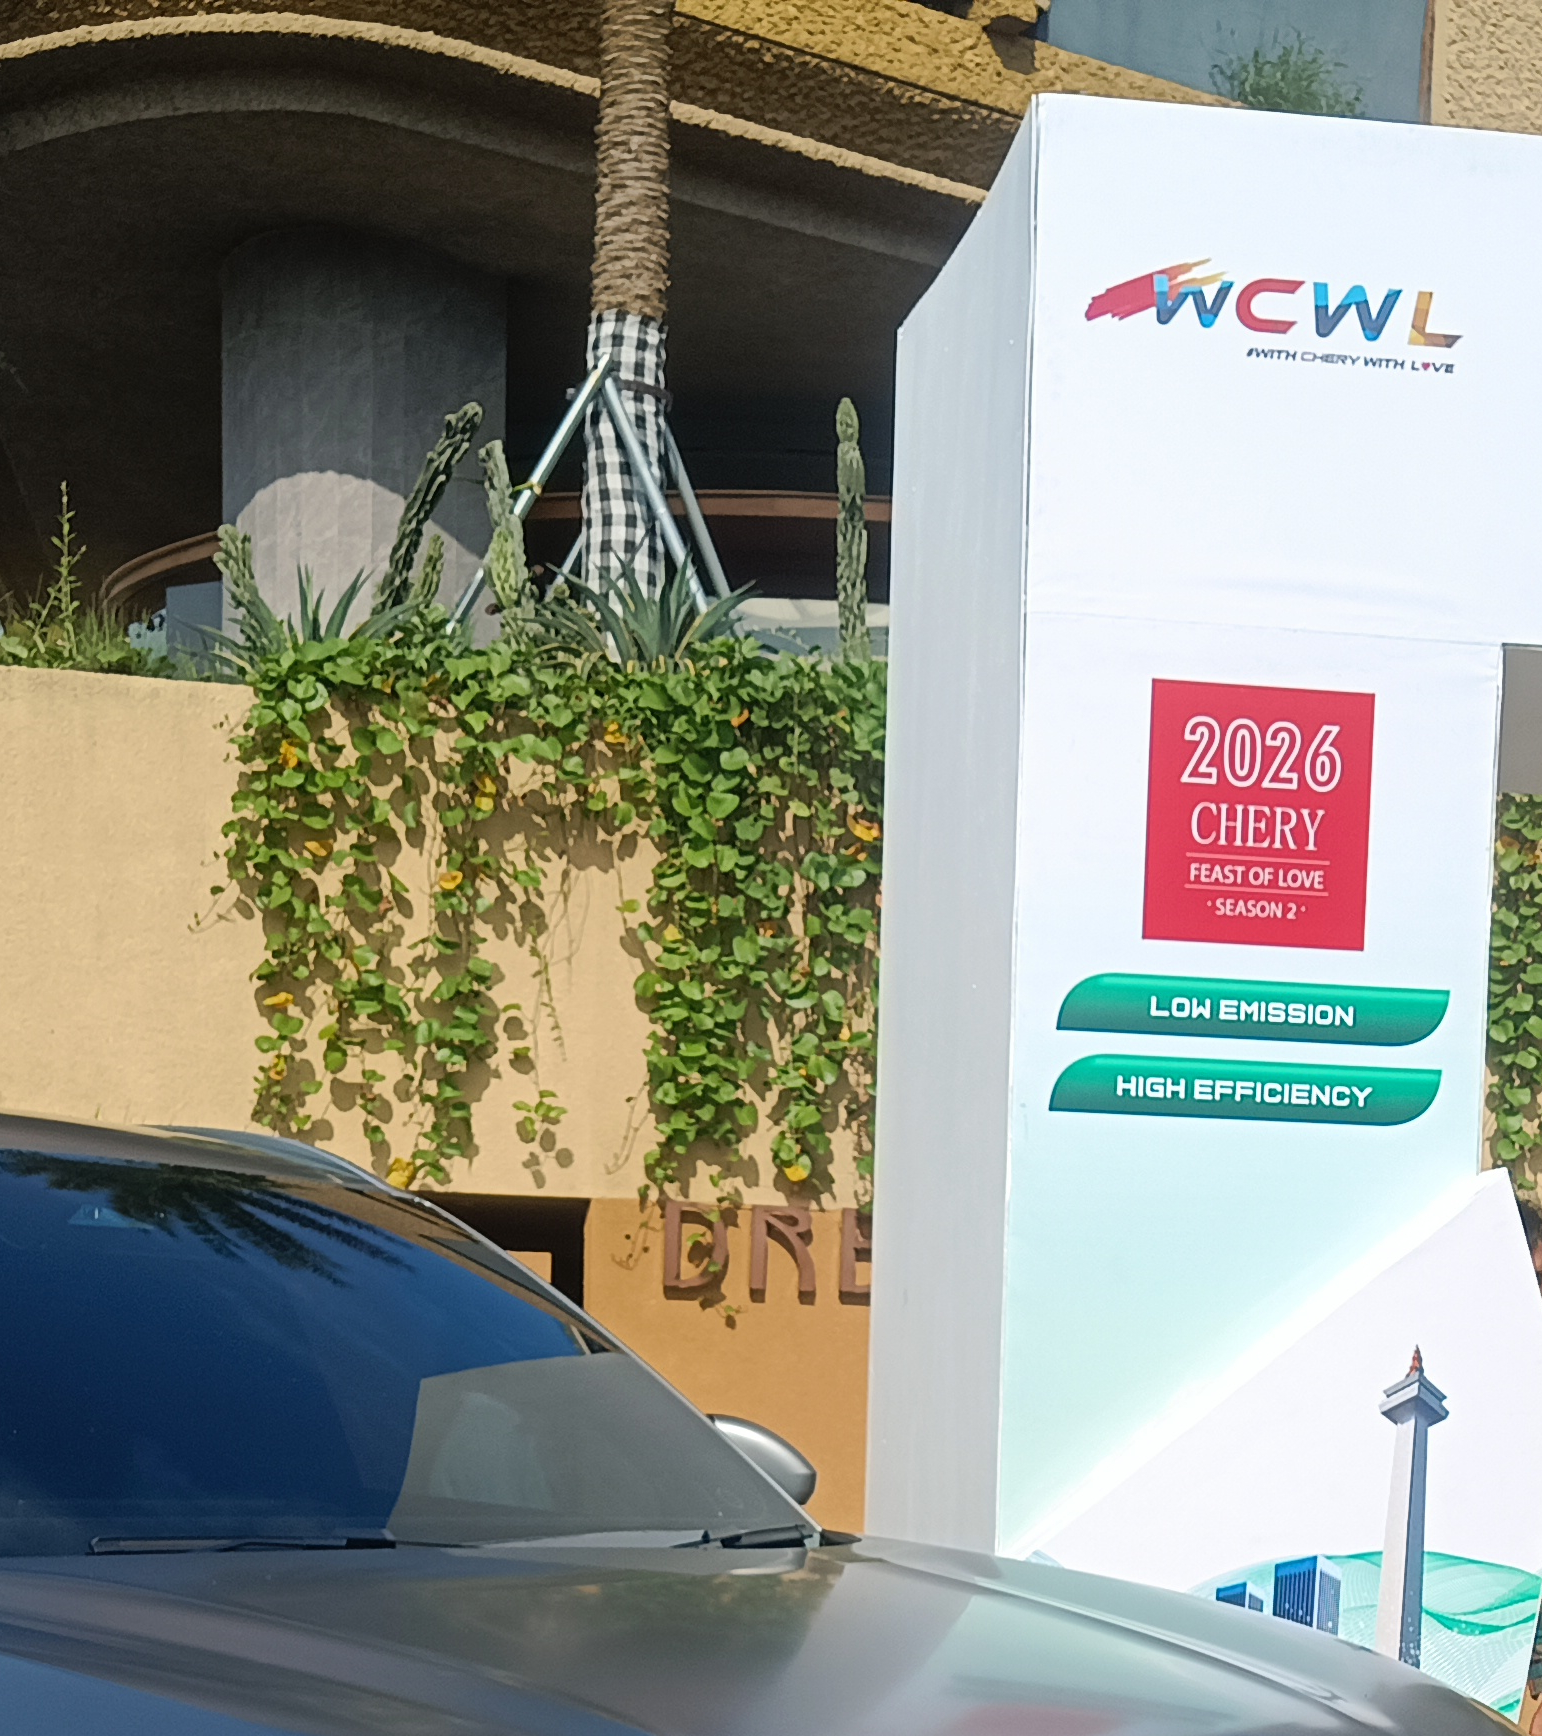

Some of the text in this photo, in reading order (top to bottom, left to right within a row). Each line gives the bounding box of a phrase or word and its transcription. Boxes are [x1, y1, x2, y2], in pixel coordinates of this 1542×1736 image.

[1152, 272, 1463, 349] WCWL
[1300, 351, 1361, 366] CHERY
[1363, 356, 1406, 370] WITH
[1180, 715, 1343, 793] 2026
[1190, 801, 1325, 852] CHERY
[1189, 863, 1324, 890] FEAST OF LOVE
[1215, 898, 1297, 920] SEASON 2
[1149, 995, 1355, 1028] LOW EMISSION
[1116, 1075, 1373, 1108] HIGH EFFICIENCY
